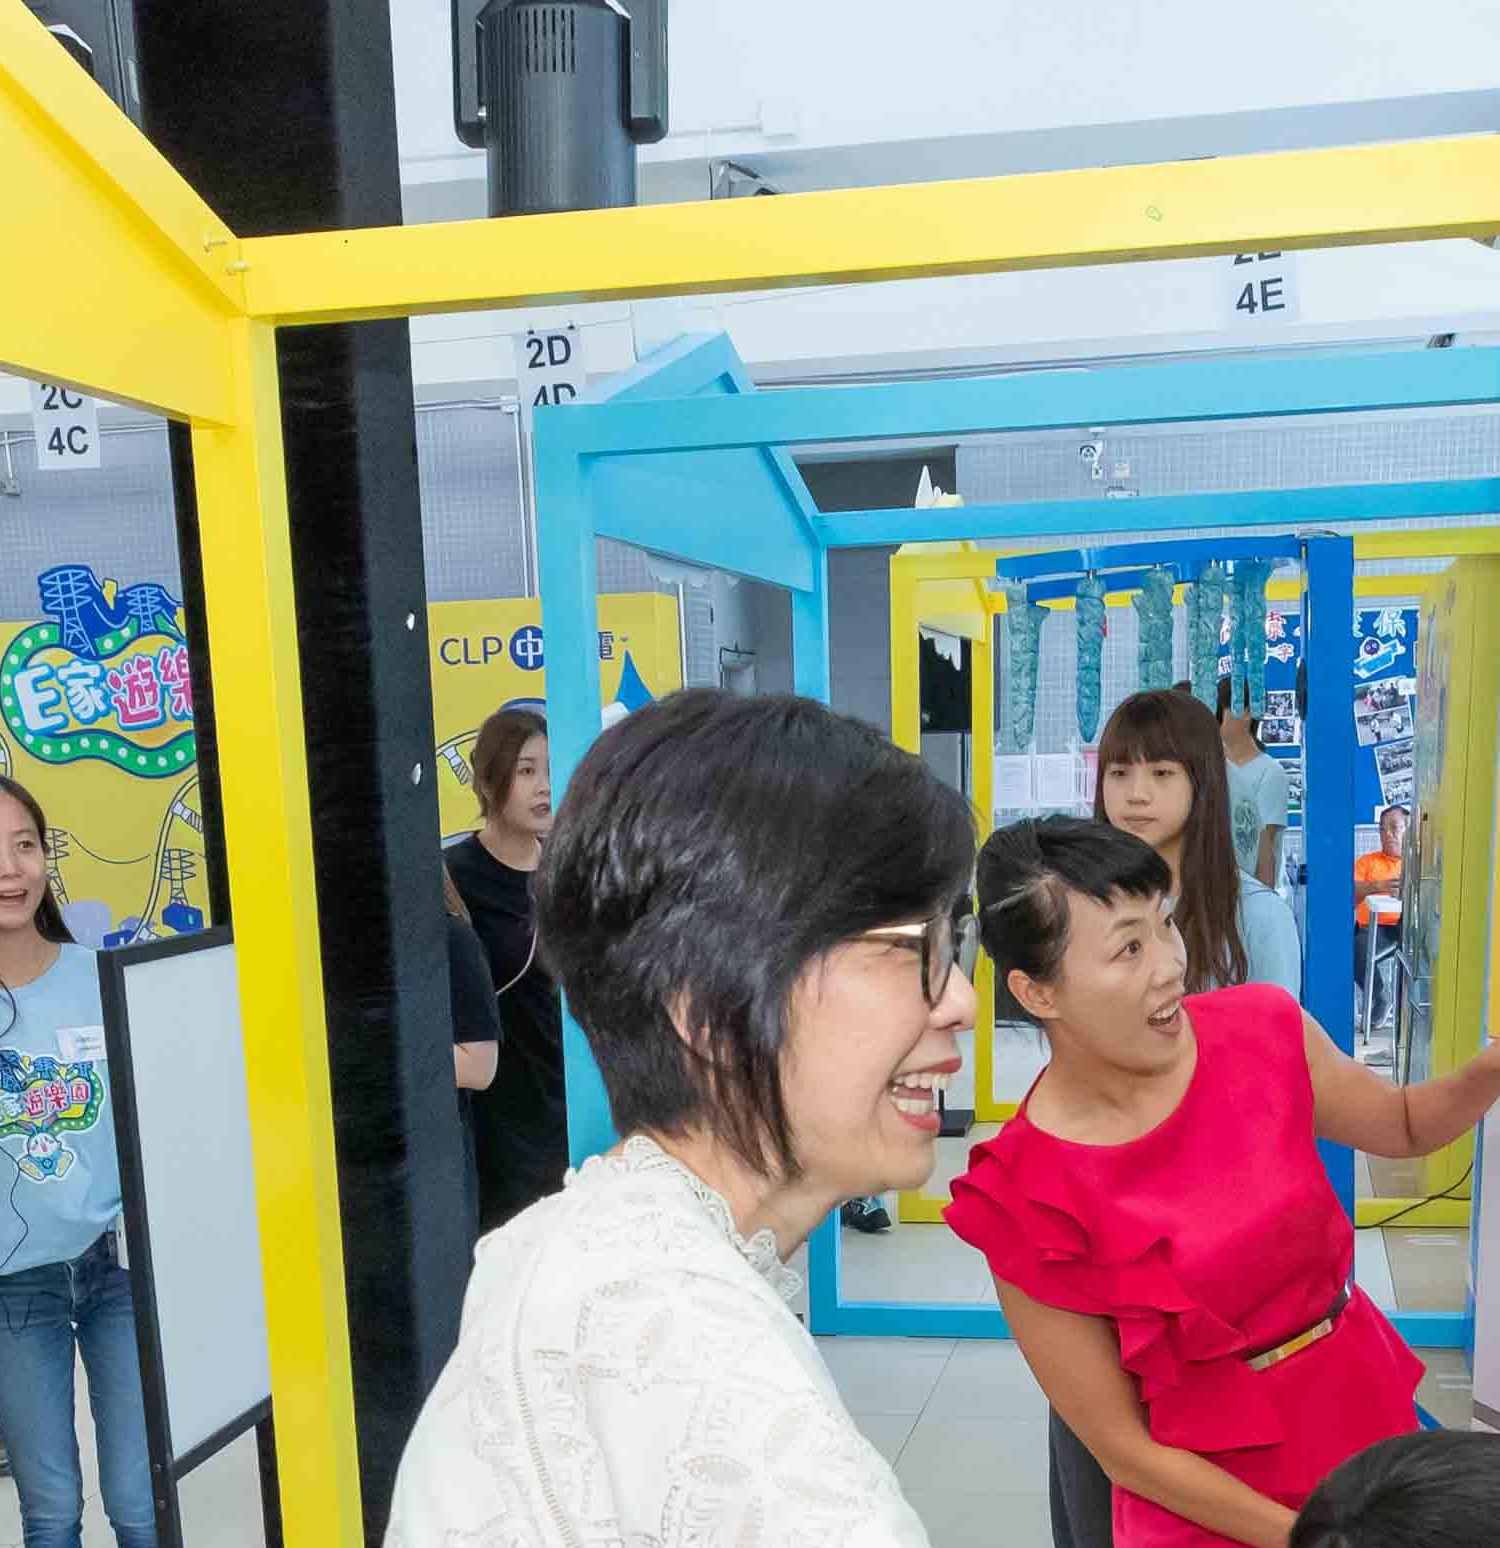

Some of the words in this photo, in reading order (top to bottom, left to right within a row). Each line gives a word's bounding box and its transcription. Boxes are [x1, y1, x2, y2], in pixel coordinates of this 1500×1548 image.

[1236, 277, 1285, 313] 4E
[526, 335, 572, 368] 2D
[47, 425, 89, 455] 4C
[440, 637, 503, 665] CLP
